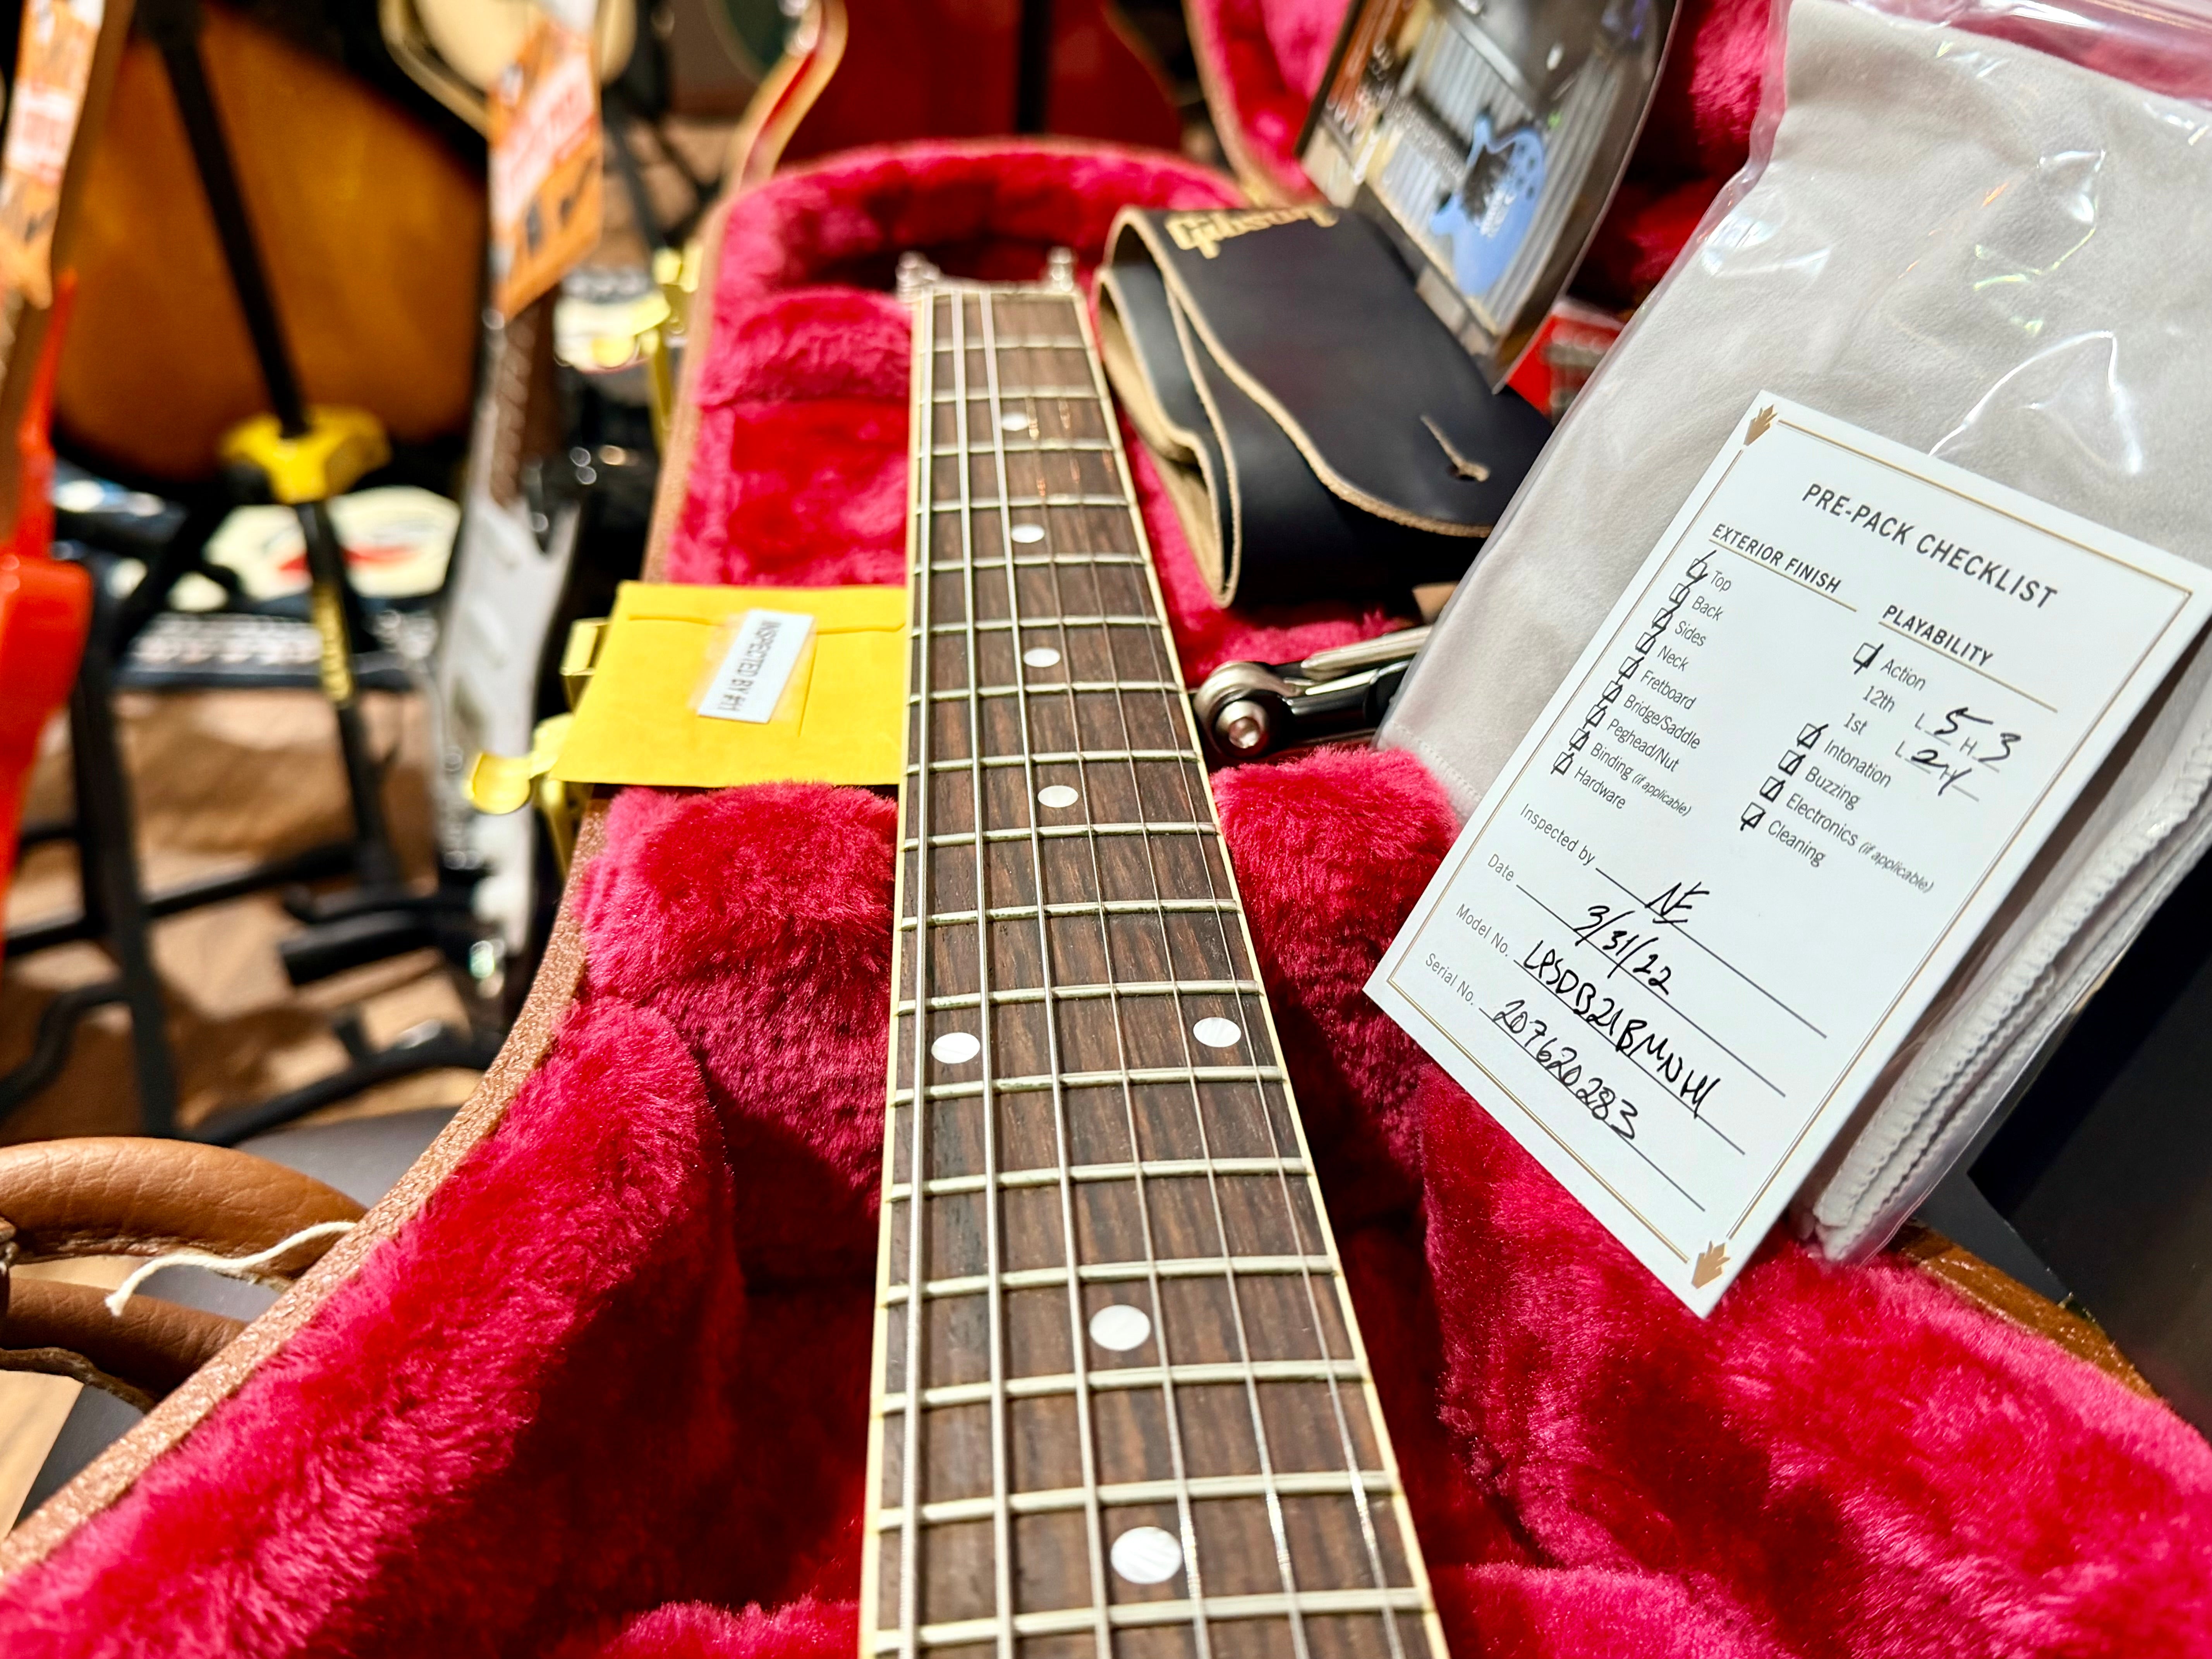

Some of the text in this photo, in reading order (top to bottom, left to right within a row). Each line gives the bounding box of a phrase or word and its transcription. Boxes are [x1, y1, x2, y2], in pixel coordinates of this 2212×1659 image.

[1712, 524, 1841, 593] EXTERIOR FINISH
[1802, 484, 2058, 608] PRE-PACK CHECKLIST
[1710, 570, 1731, 592] Top
[1692, 596, 1724, 621] Back
[737, 620, 781, 677] INSPECTED
[1657, 646, 1689, 671] Neck
[1675, 621, 1706, 647] Sides
[1882, 605, 1993, 667] PLAYABILITY
[729, 679, 754, 694] BY
[1640, 670, 1696, 709] Fretboard
[1863, 686, 1895, 713] 12th
[1881, 659, 1926, 691] Action
[1607, 719, 1680, 772] Peghead/Nut
[1624, 694, 1700, 749] Bridge/Saddle
[1844, 713, 1868, 735] 1st
[1934, 708, 2021, 762] 5 3
[1574, 766, 1626, 809] Hardware
[1591, 743, 1691, 817] Binding (if applicable)
[1805, 766, 1861, 811] Buzzing
[1824, 739, 1891, 788] Intonation
[1520, 804, 1595, 866] Inspected by
[1768, 820, 1826, 867] Cleaning
[1786, 793, 1934, 893] Electronics (if applicable)
[1487, 854, 1514, 881] Date
[1456, 903, 1508, 957] Model No.
[1573, 906, 1671, 995] 3/31/22
[1425, 953, 1474, 1005] Serial No.
[1492, 1000, 1637, 1139] 207620283
